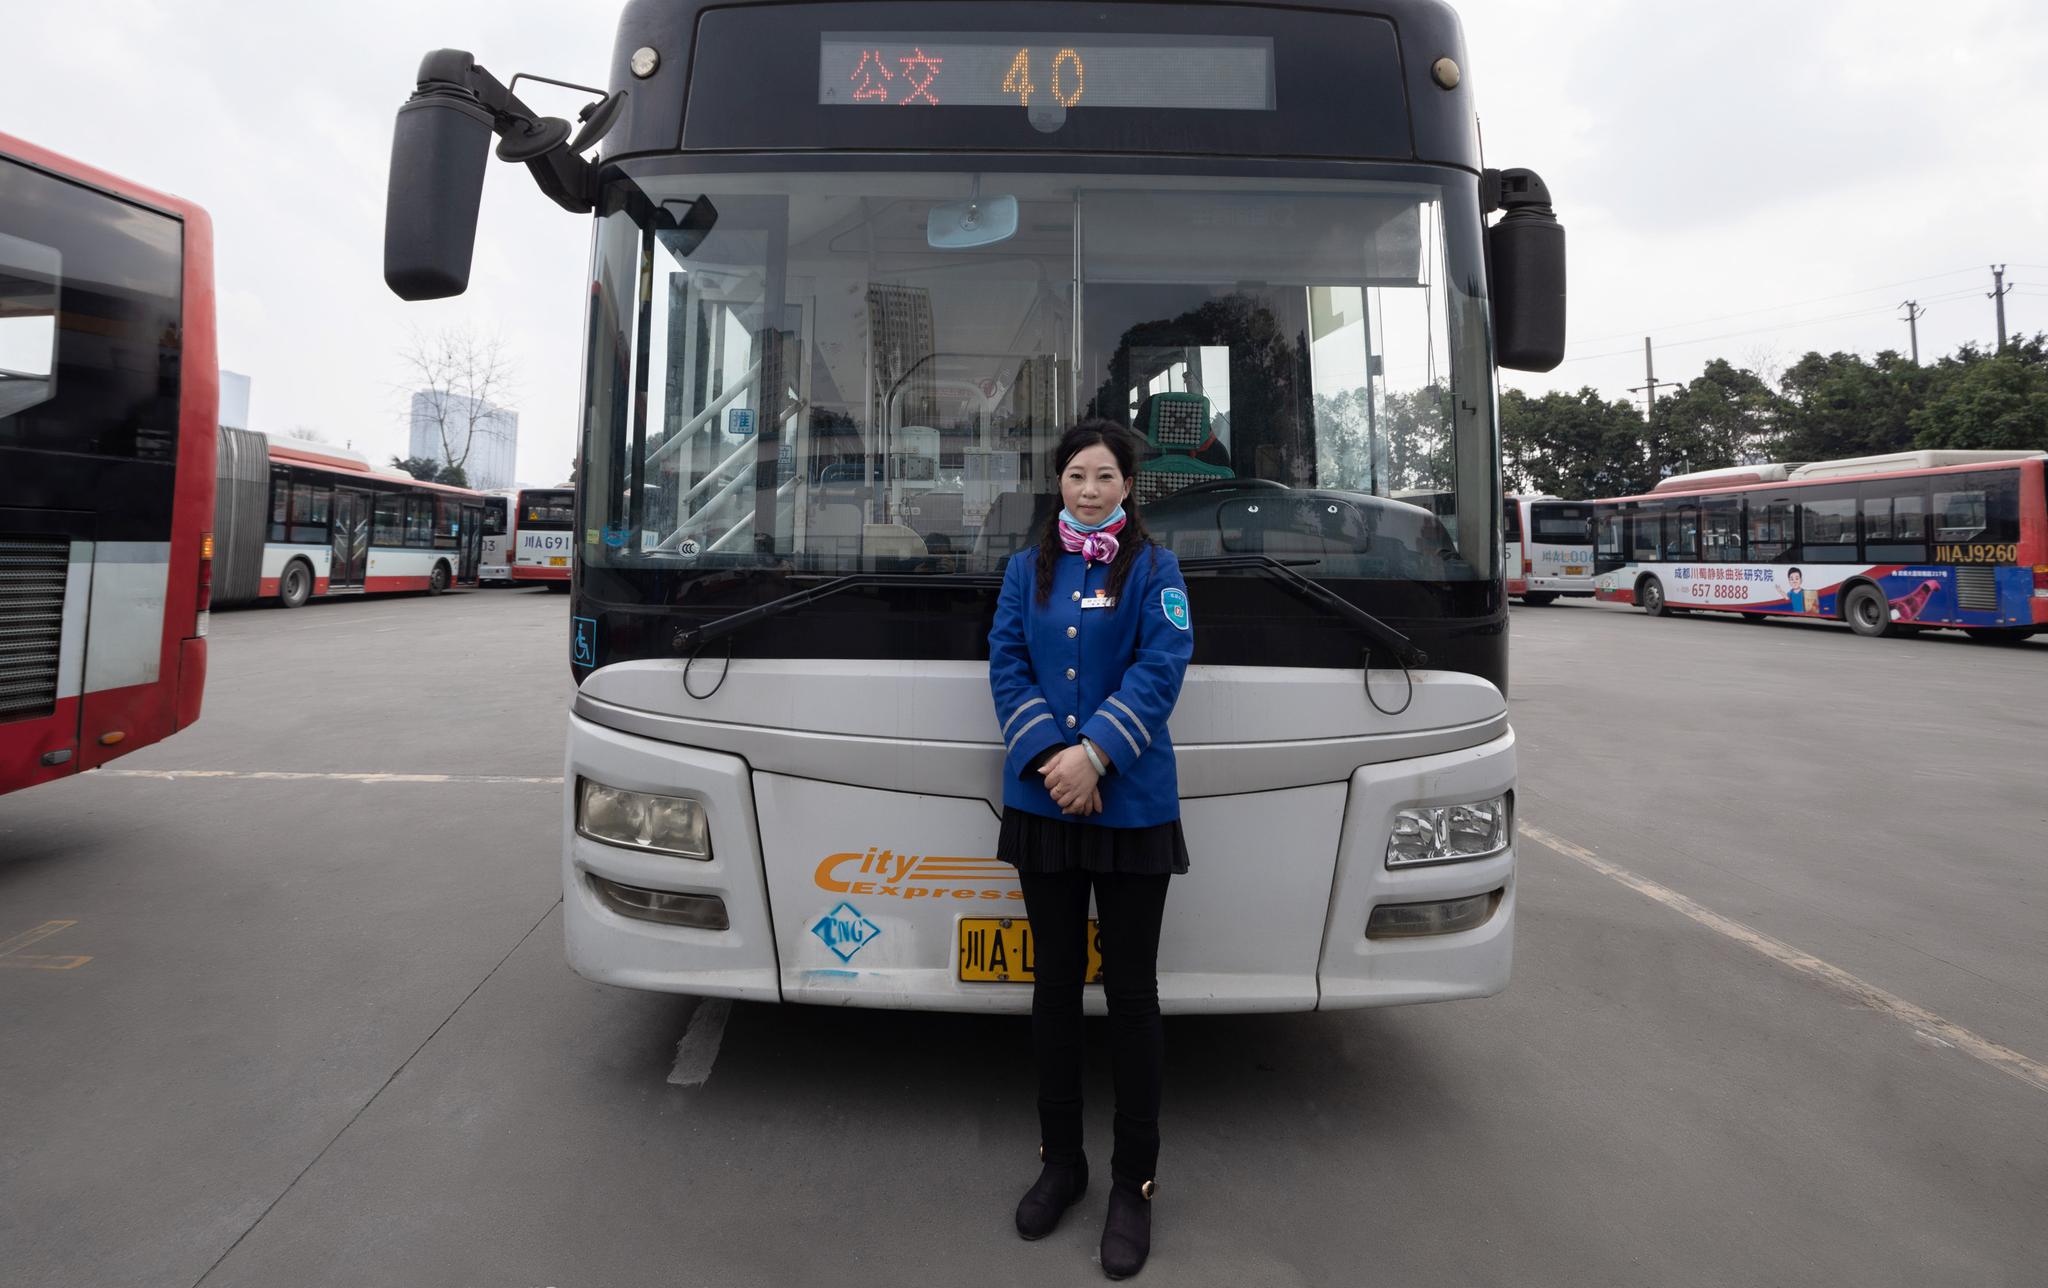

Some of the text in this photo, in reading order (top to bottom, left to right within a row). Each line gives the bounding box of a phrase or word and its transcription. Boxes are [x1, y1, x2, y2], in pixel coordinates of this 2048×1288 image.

[850, 48, 1084, 107] 公交 40
[1935, 544, 2017, 562] 川AJ9260
[1691, 583, 1711, 598] 657
[1714, 584, 1749, 599] 88888
[814, 847, 919, 892] City
[851, 881, 1024, 899] Express
[823, 916, 864, 945] CNG
